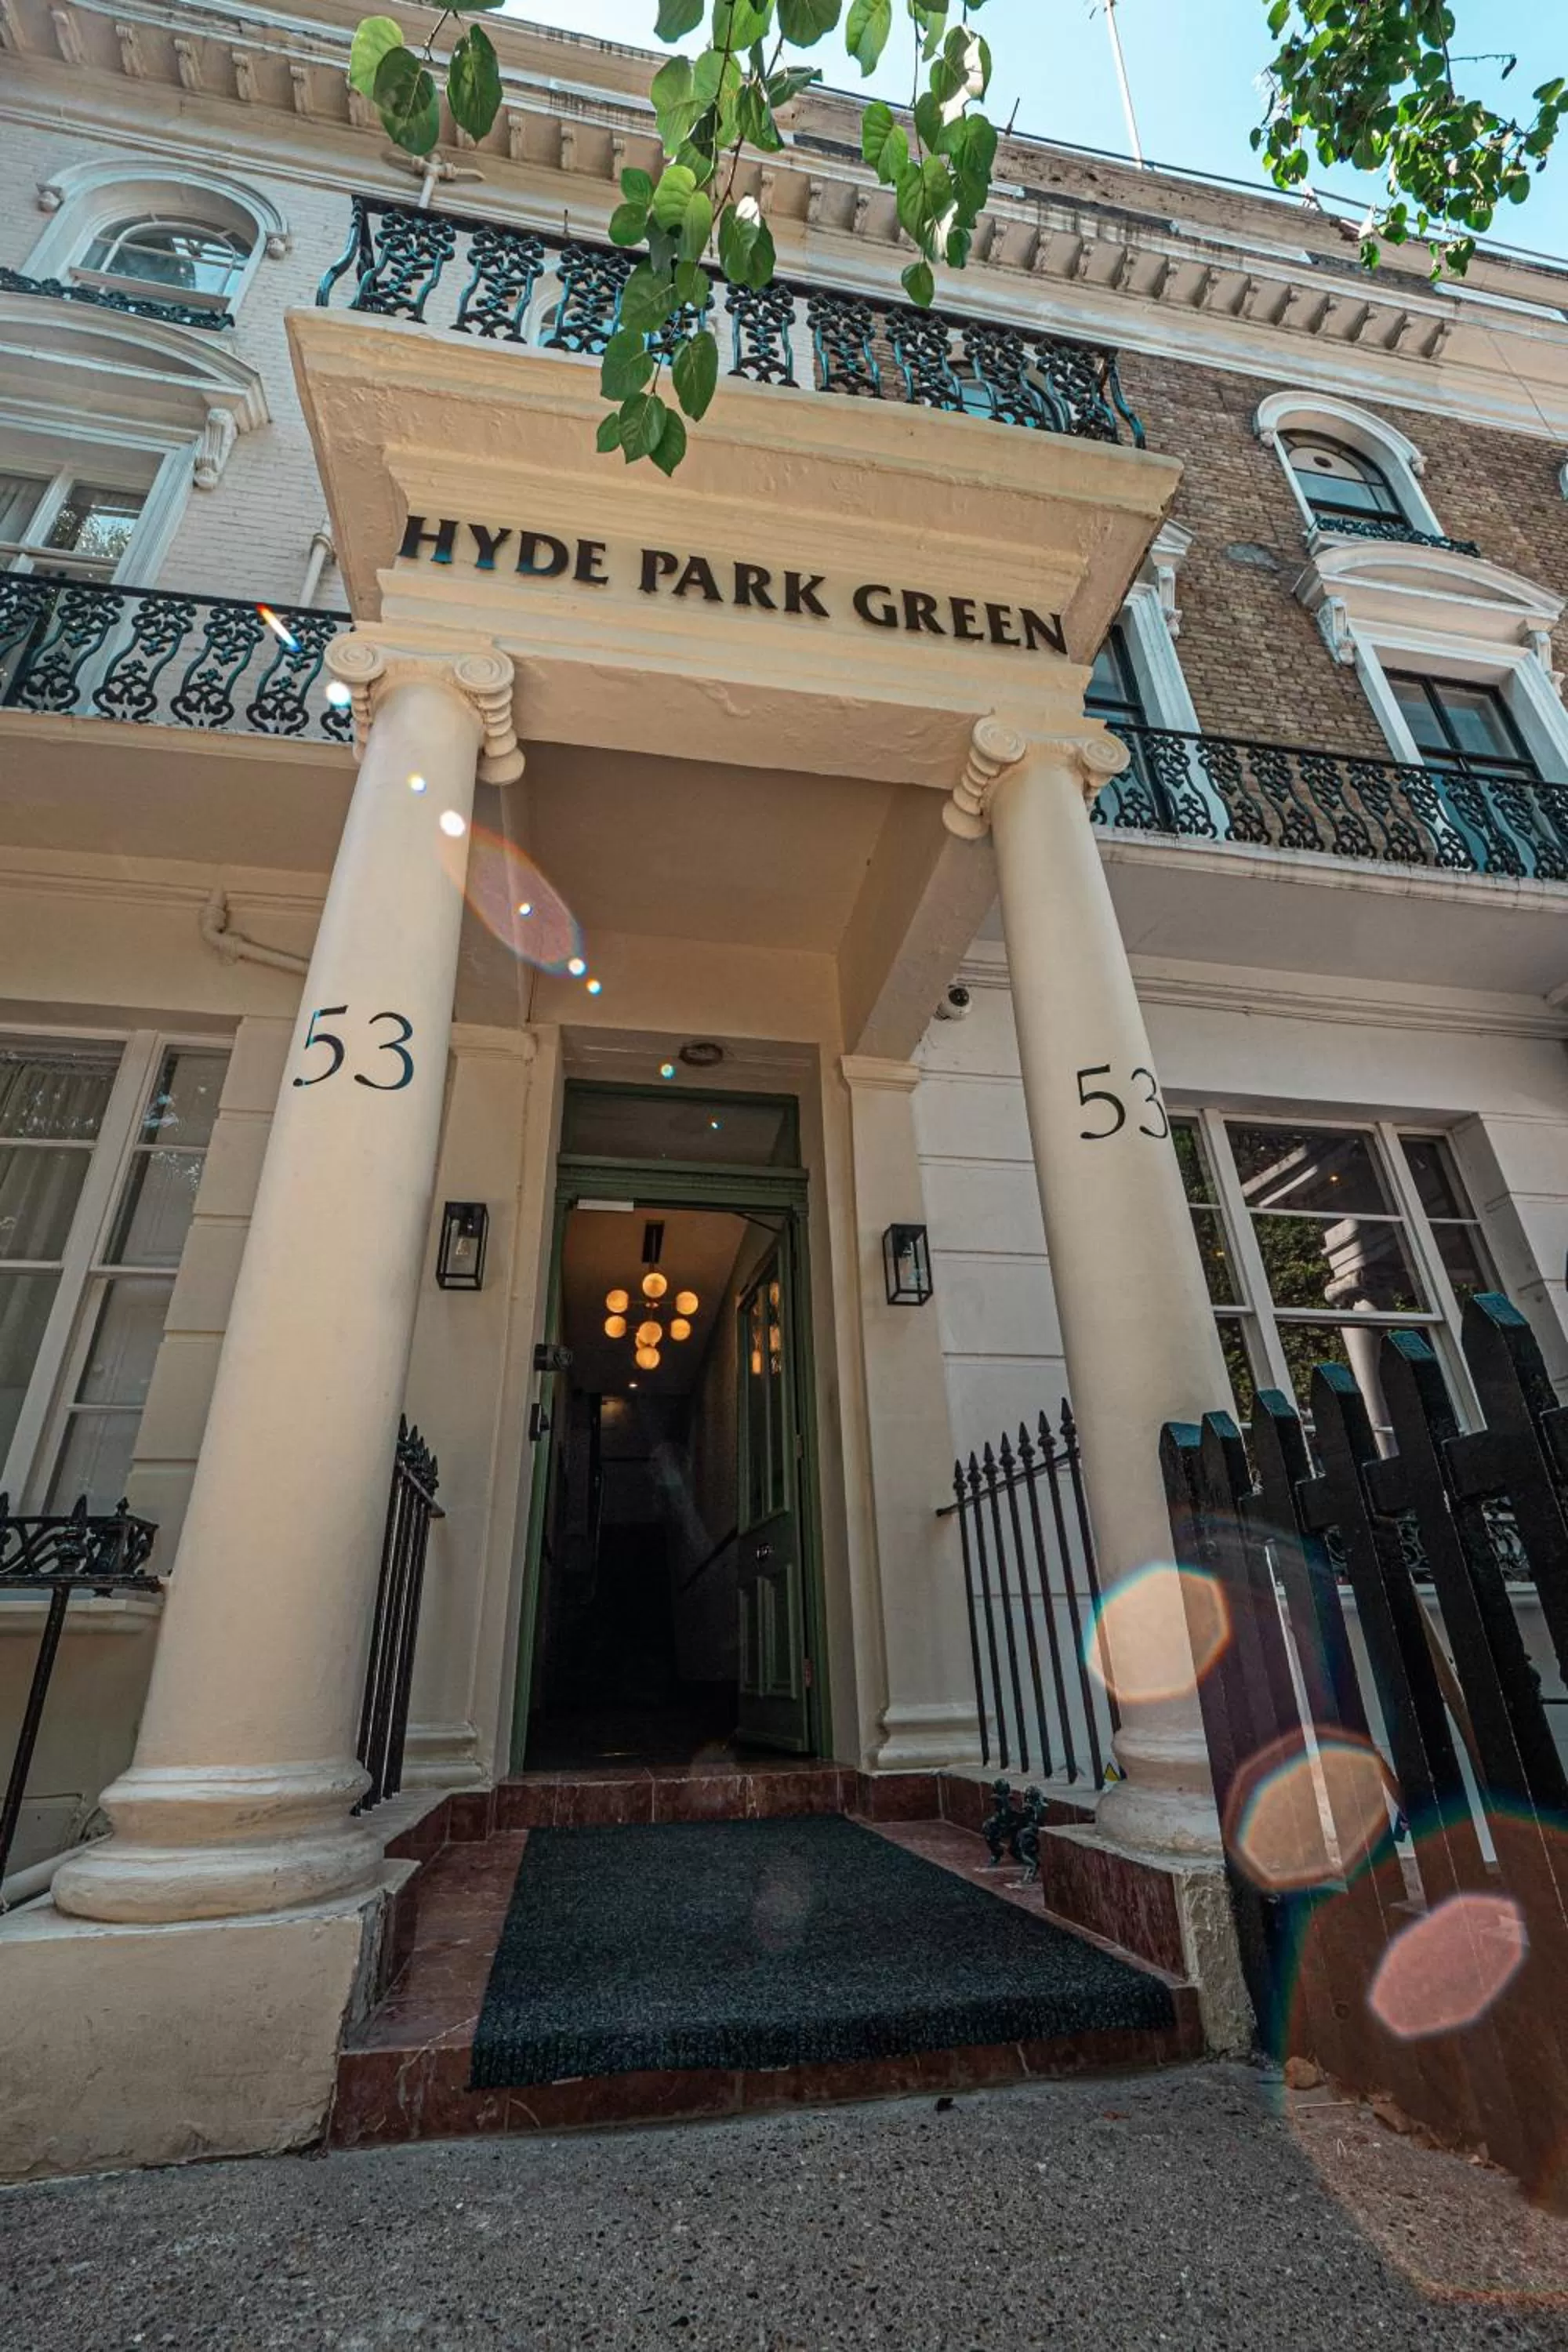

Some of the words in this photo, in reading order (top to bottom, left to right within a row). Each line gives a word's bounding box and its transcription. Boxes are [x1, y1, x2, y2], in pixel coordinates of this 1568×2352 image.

[398, 514, 609, 586] HYDE
[637, 548, 830, 619] PARK
[852, 583, 1069, 655] GREEN
[292, 1004, 415, 1091] 53
[1076, 1063, 1168, 1140] 53
